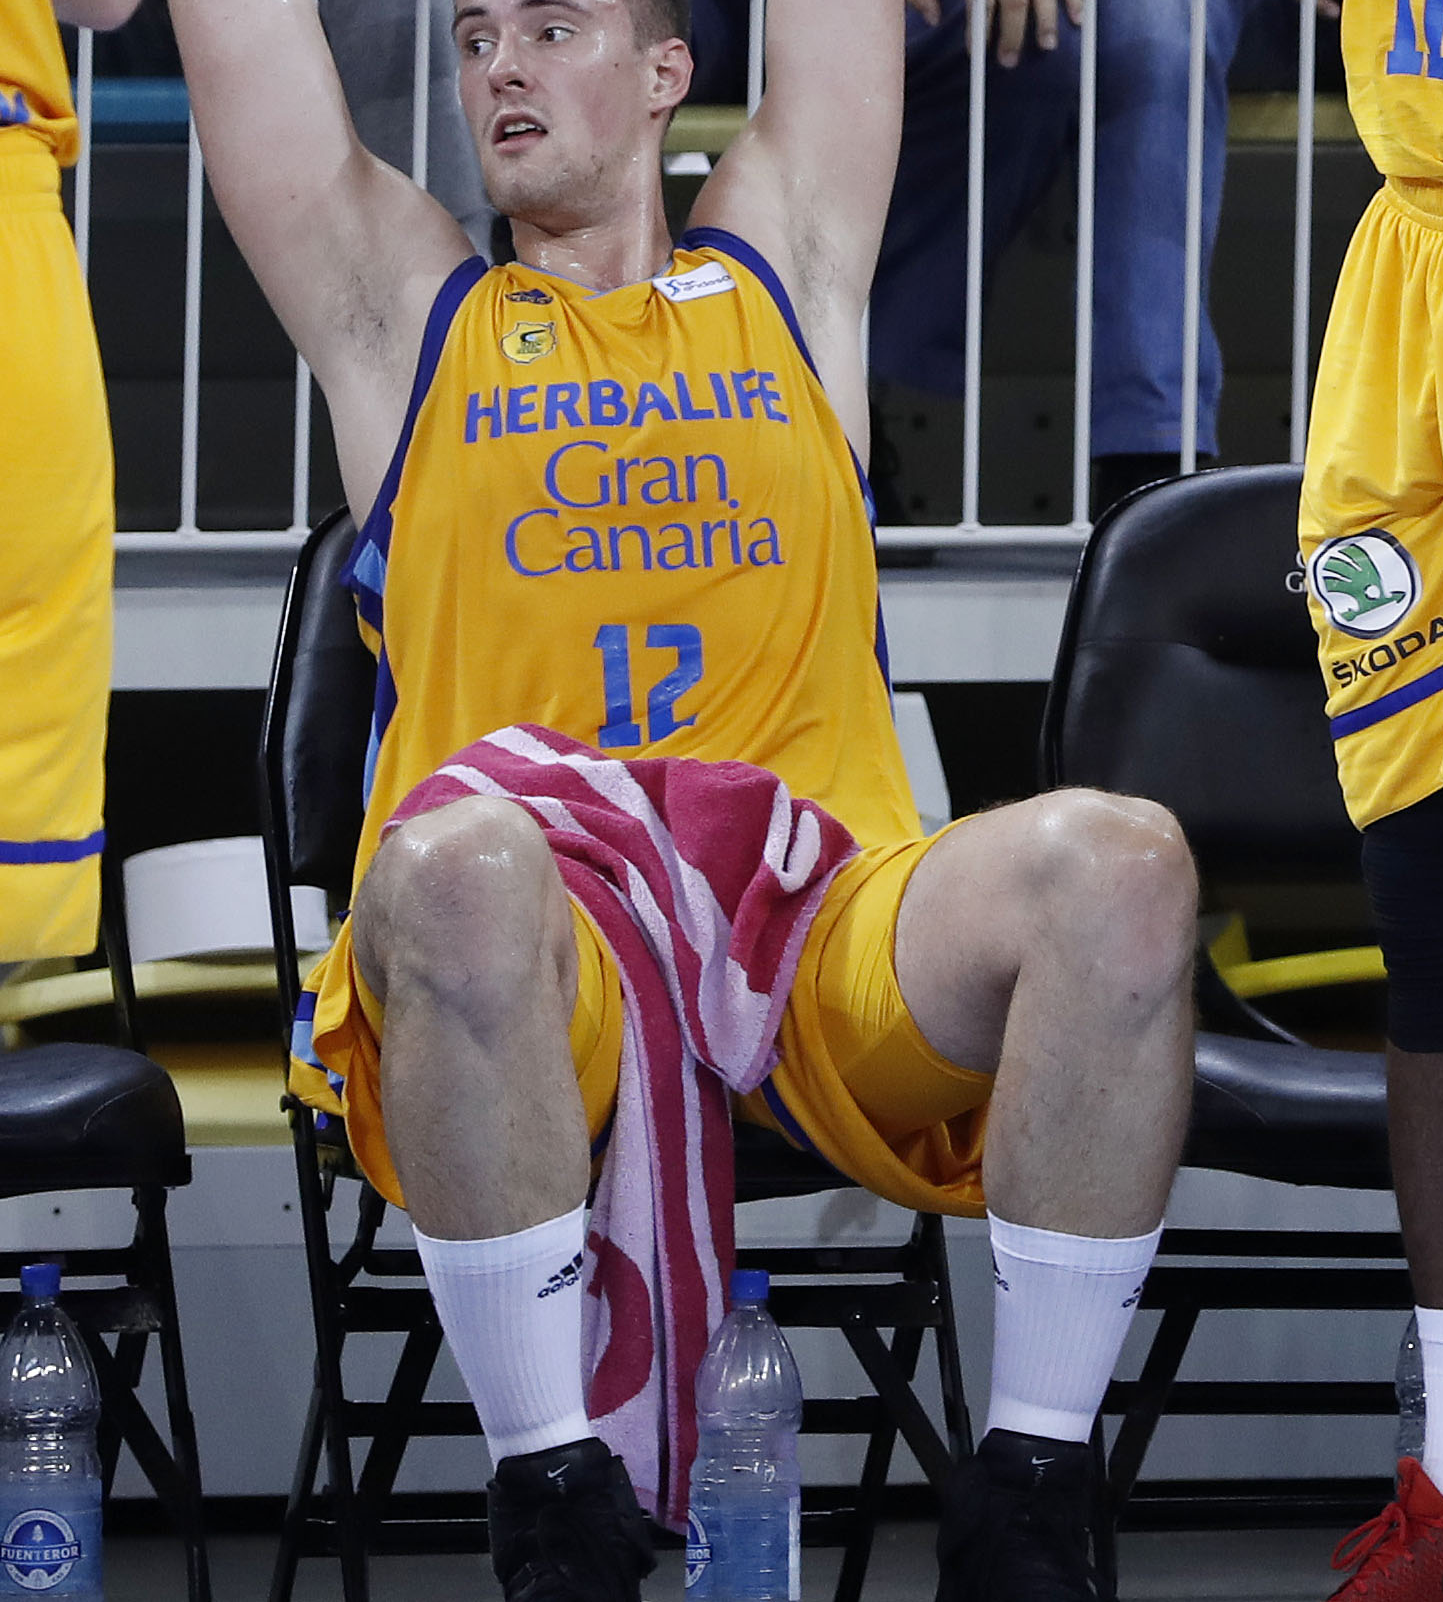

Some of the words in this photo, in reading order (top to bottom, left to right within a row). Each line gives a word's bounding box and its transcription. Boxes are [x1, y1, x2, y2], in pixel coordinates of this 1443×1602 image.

[464, 368, 790, 444] HERBALIFE
[544, 440, 729, 509] Gran
[504, 499, 786, 577] Canaria
[592, 623, 704, 748] 12
[1, 1545, 80, 1561] FUENTEROR
